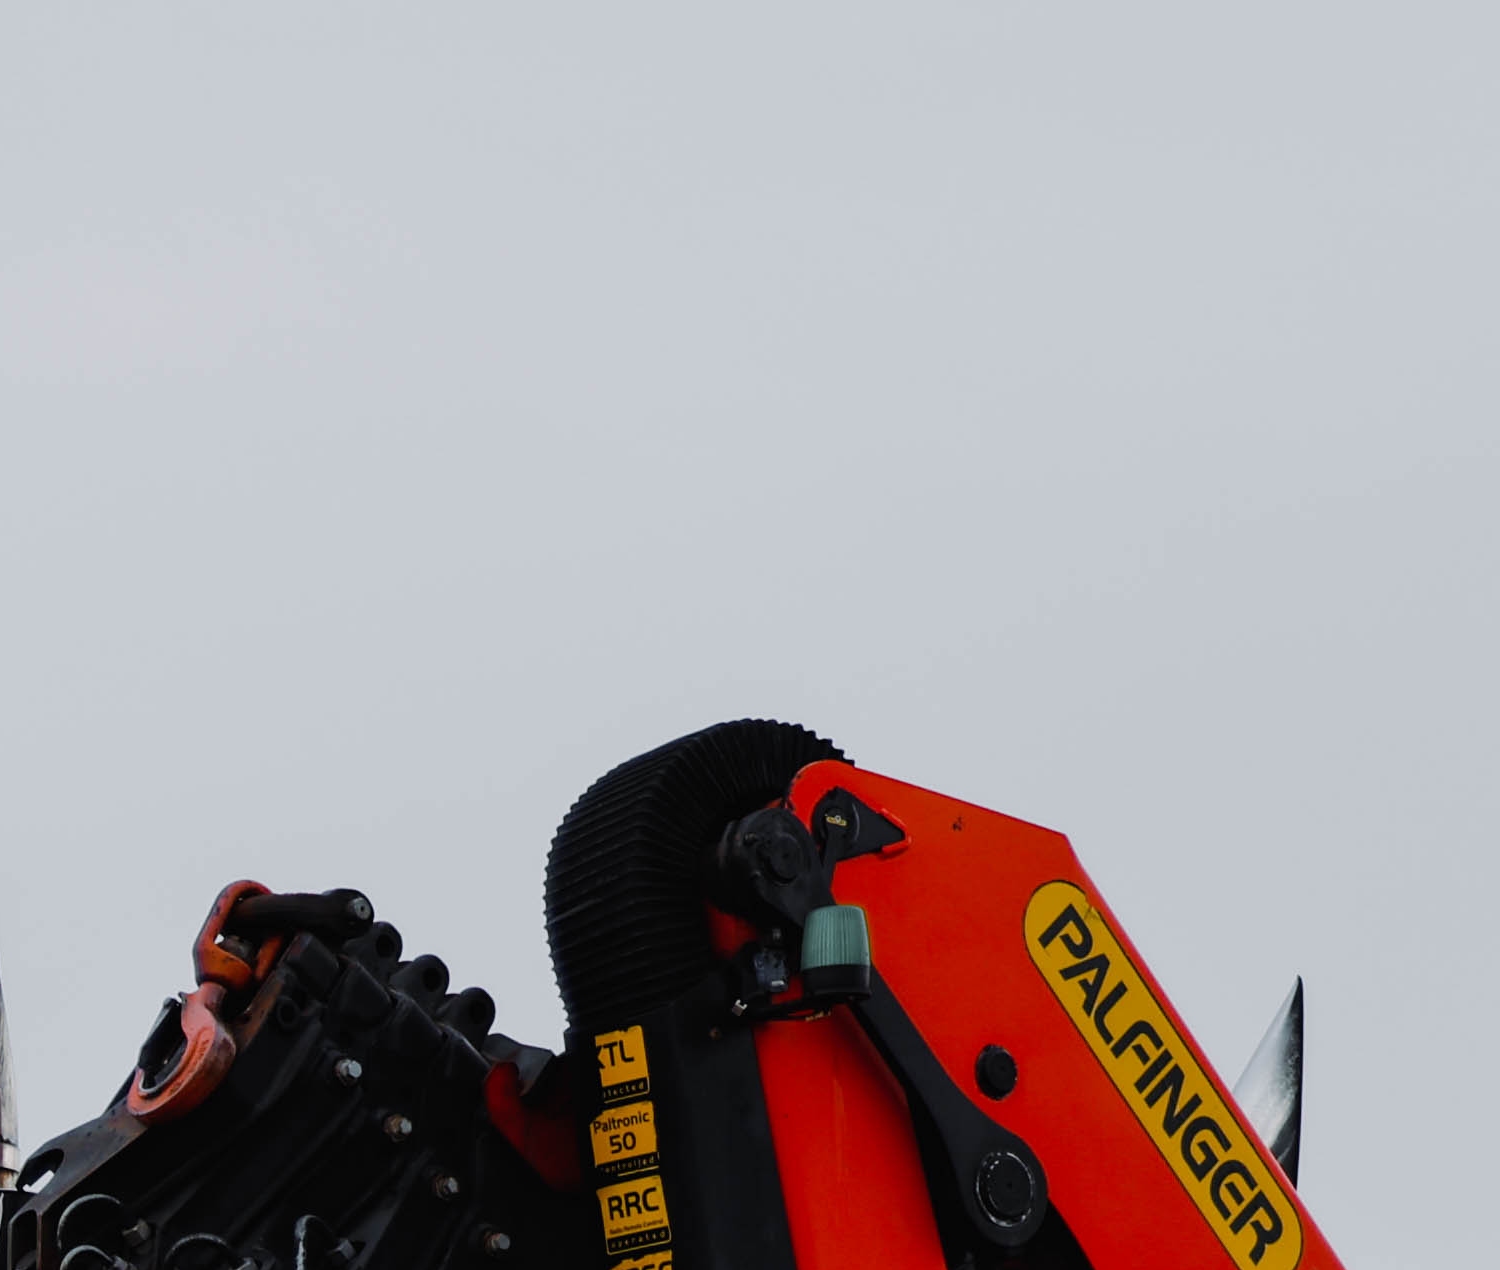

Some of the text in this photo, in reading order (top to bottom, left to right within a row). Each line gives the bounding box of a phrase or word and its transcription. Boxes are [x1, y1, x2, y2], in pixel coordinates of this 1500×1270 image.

[1038, 903, 1283, 1267] PALFINGER
[593, 1111, 651, 1134] Paltronic
[609, 1131, 637, 1154] 50
[607, 1186, 660, 1222] RRC
